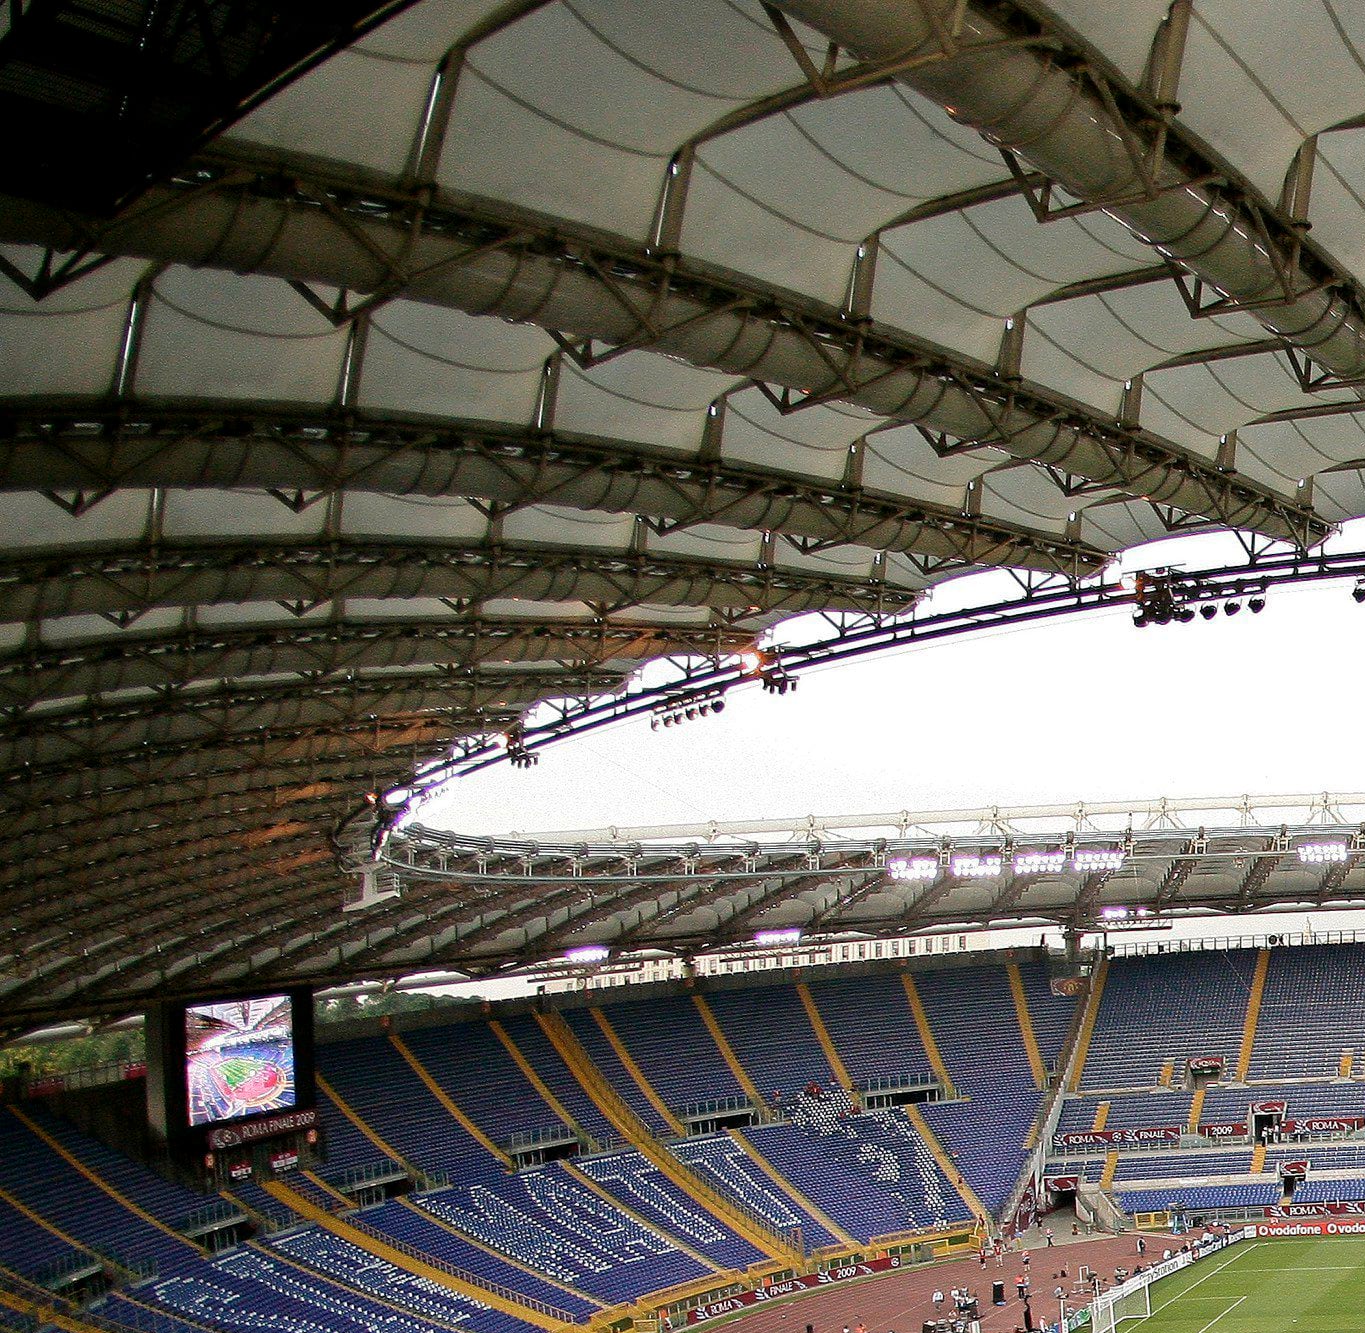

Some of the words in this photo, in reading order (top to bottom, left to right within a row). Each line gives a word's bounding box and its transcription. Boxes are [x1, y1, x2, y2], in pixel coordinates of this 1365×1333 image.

[1312, 1122, 1338, 1130] ROMA
[1069, 1134, 1094, 1144] ROMA
[1140, 1130, 1165, 1139] FINALE
[1211, 1127, 1233, 1136] 2009
[1289, 1207, 1317, 1215] ROMA
[1268, 1225, 1321, 1235] vodafone
[710, 1302, 732, 1315] ROMA
[770, 1282, 793, 1295] FINALE
[837, 1267, 857, 1279] 2009
